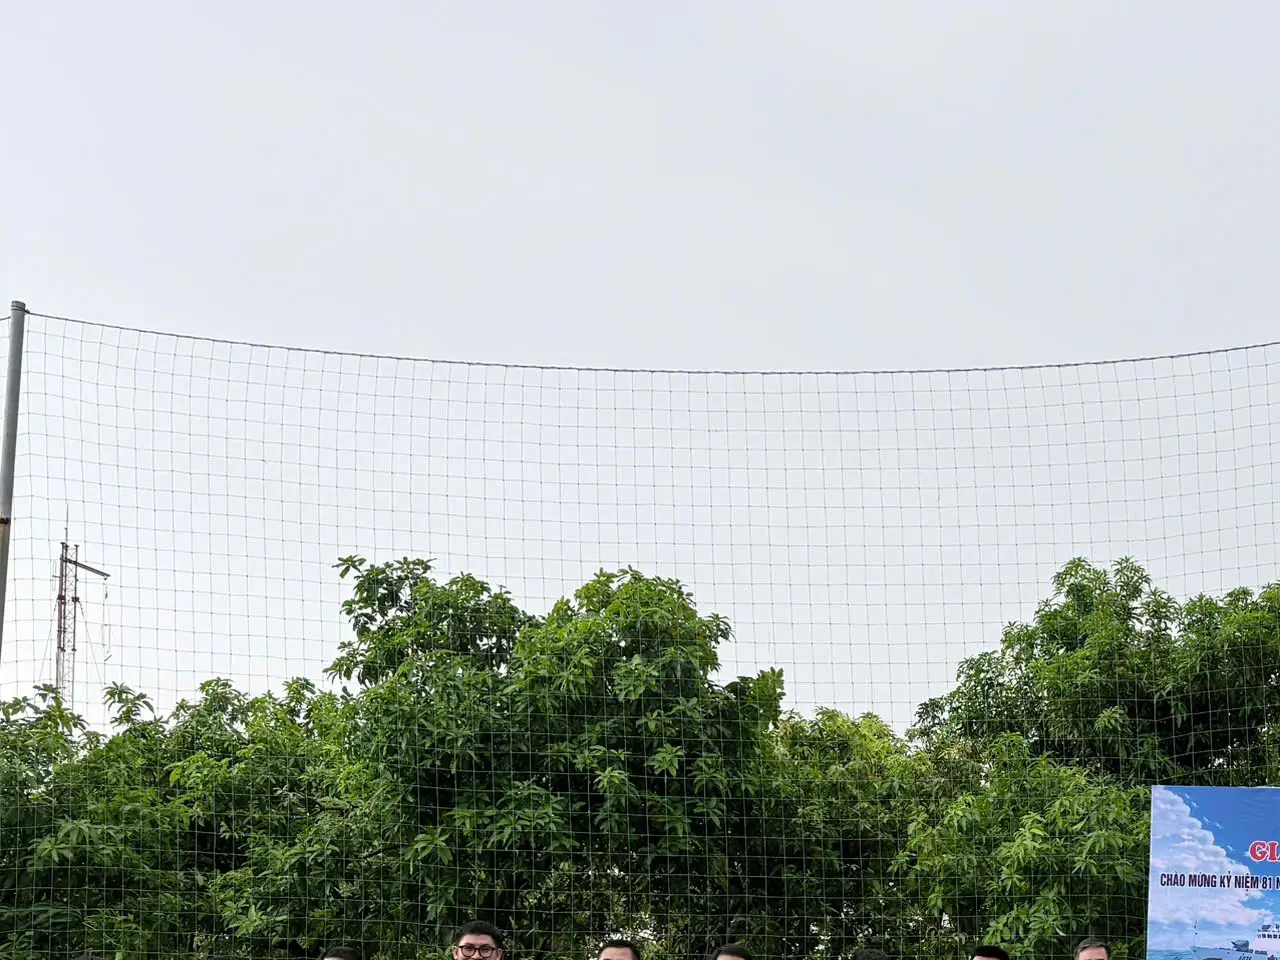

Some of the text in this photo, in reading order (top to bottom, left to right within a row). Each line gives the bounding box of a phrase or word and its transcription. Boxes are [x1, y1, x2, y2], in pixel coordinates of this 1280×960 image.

[1160, 871, 1186, 887] CHÀO
[1188, 871, 1217, 888] MỪNG
[1219, 871, 1232, 888] KỶ
[1234, 873, 1259, 892] NIỆM
[1261, 875, 1272, 889] 81
